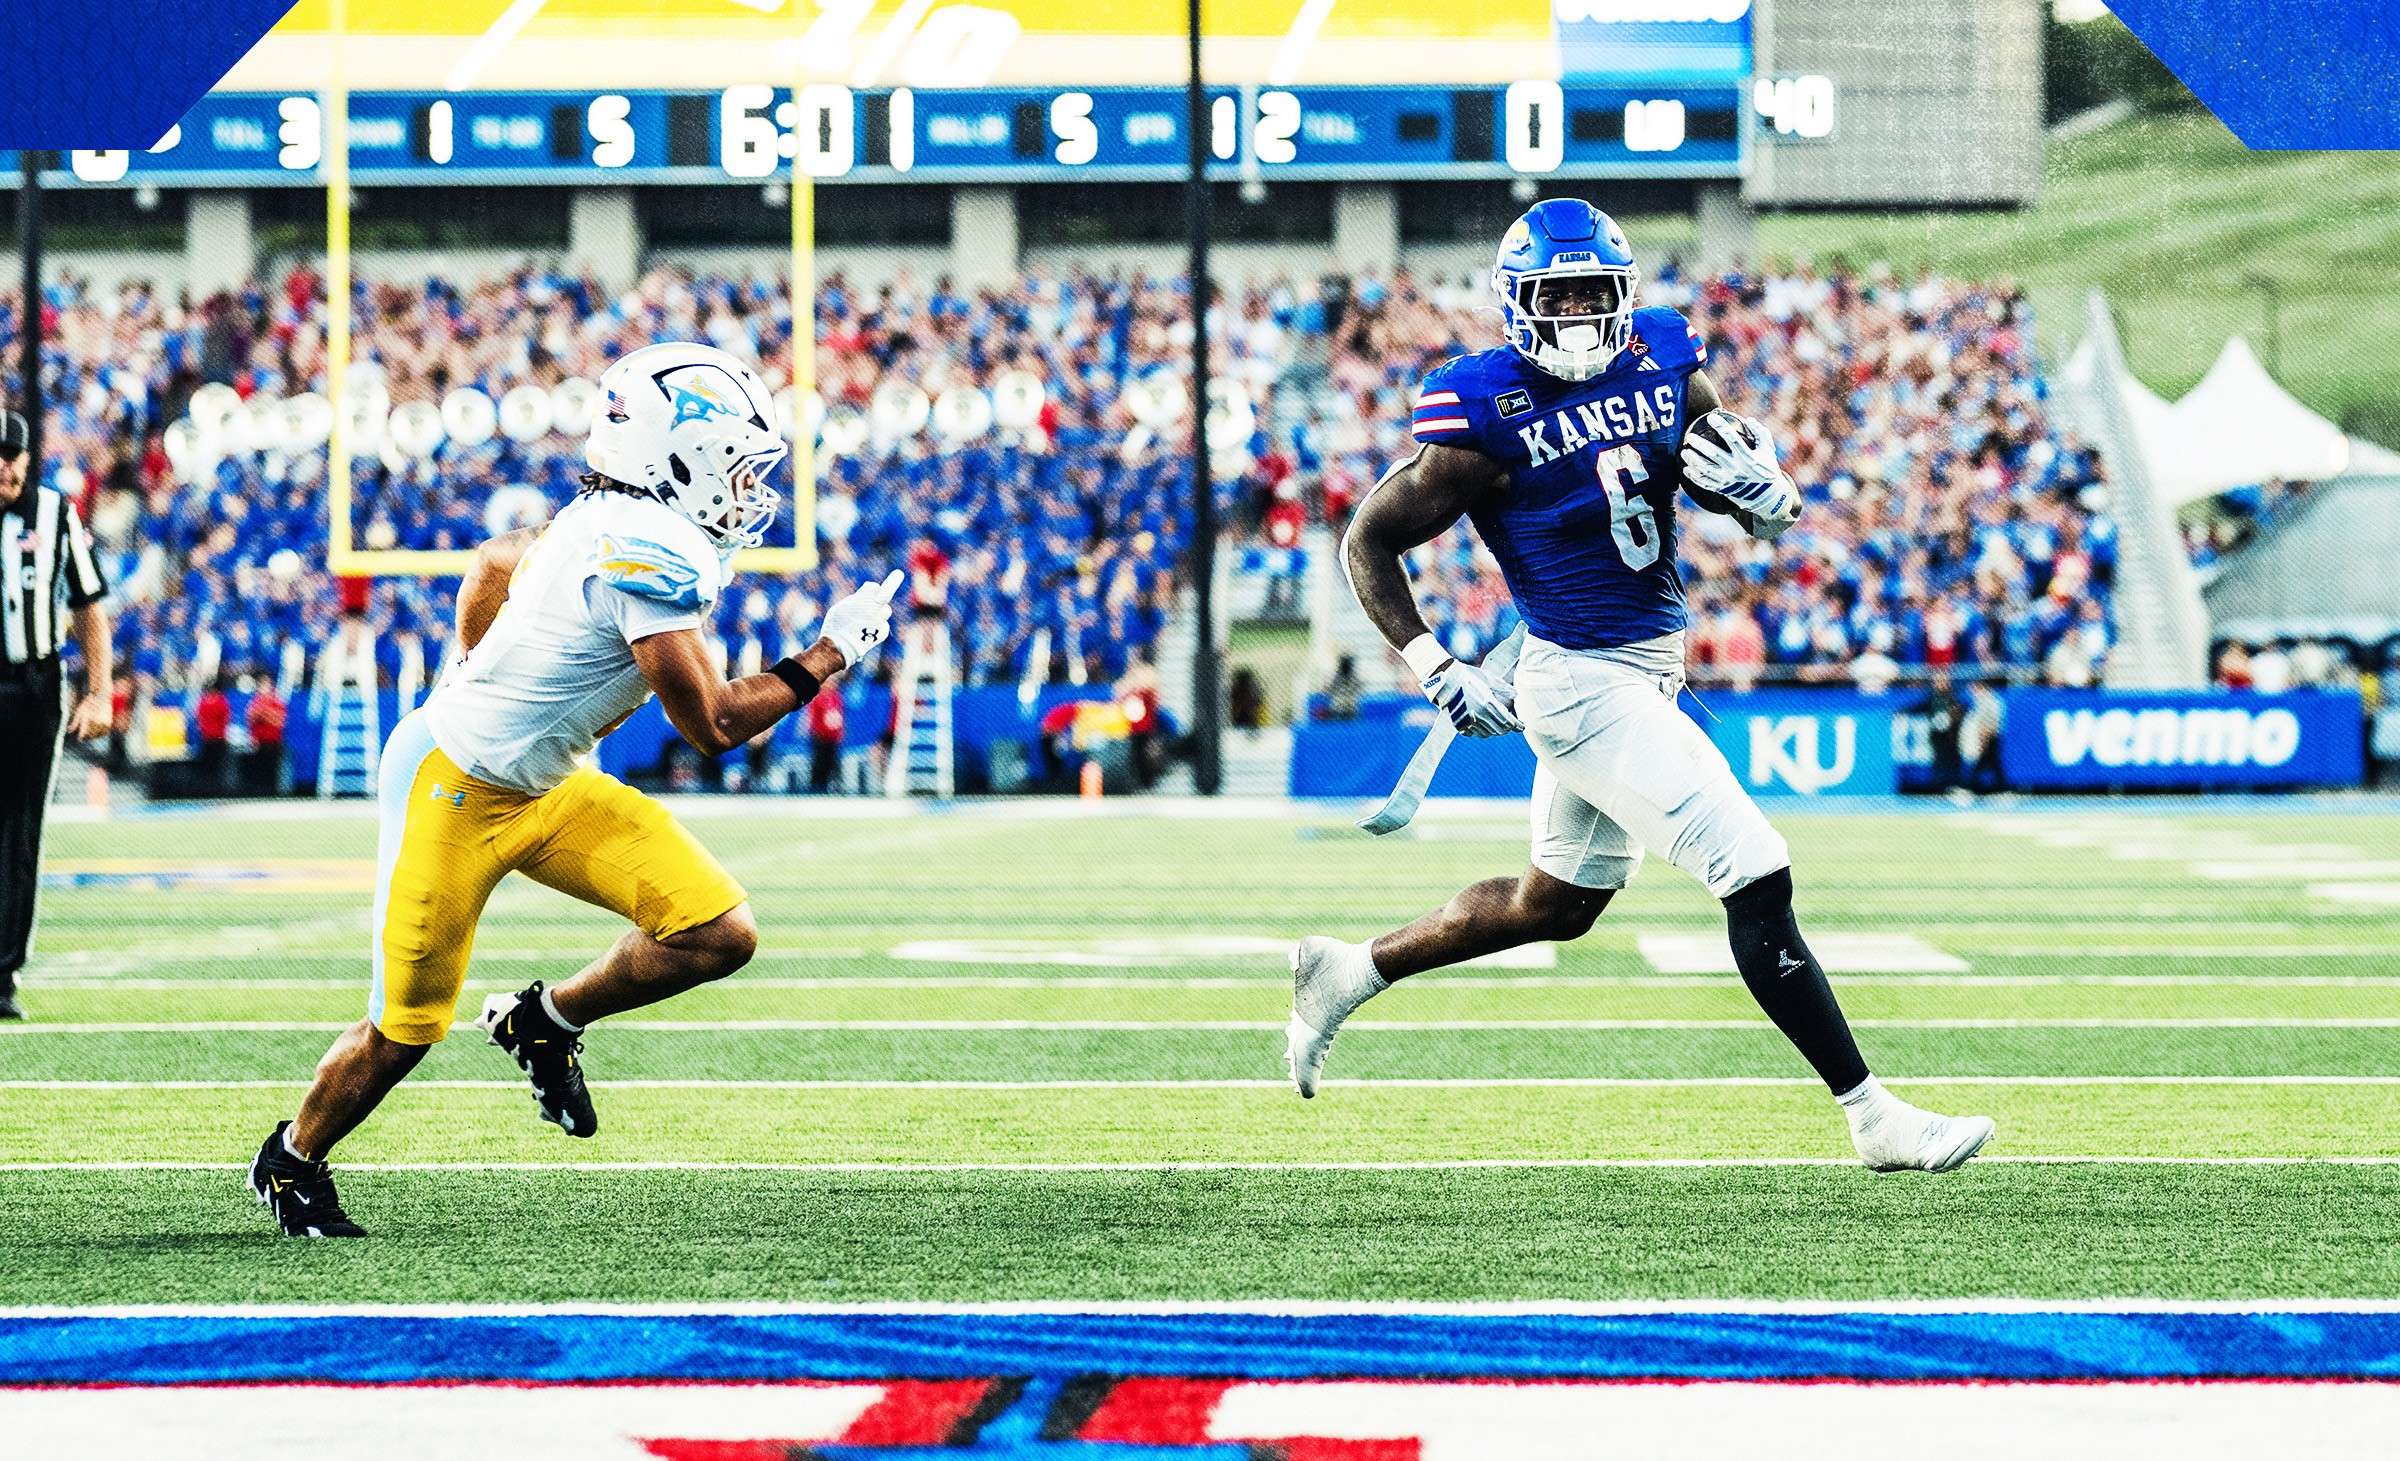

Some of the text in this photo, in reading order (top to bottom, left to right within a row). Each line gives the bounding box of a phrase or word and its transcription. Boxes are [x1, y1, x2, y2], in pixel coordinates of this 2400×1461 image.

[278, 96, 320, 169] 3
[1505, 79, 1563, 172] 0
[1559, 252, 1591, 263] KANSAS
[1518, 384, 1676, 468] KANSAS
[1596, 443, 1661, 572] 6
[1750, 715, 1856, 793] KU
[2045, 708, 2300, 767] venmo
